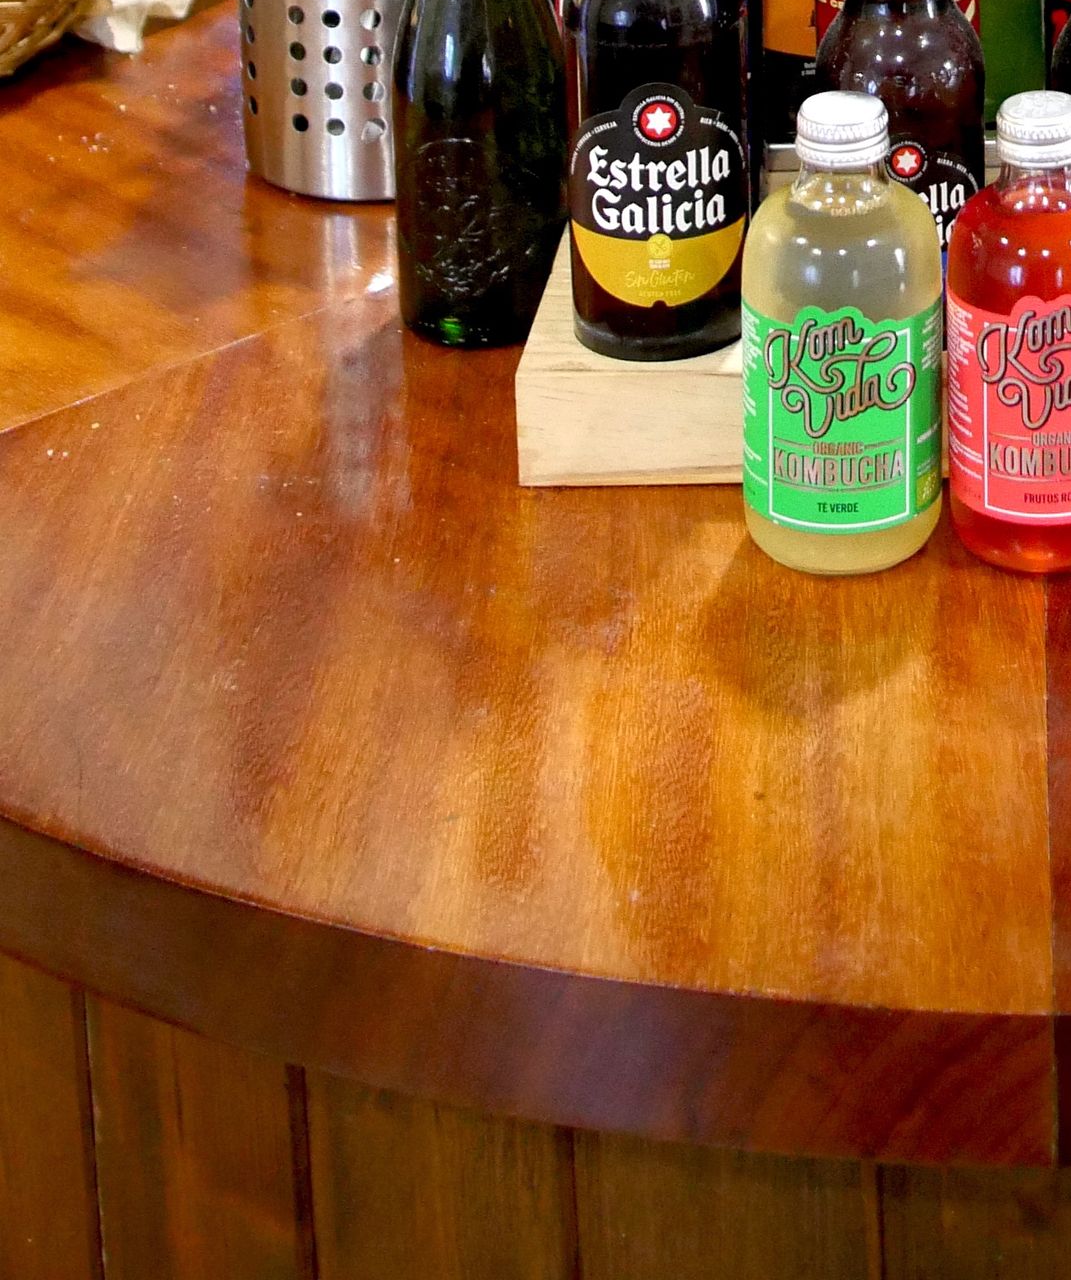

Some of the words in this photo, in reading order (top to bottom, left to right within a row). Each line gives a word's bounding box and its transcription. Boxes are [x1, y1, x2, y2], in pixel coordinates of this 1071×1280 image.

[586, 144, 730, 192] Estrella
[591, 188, 726, 234] Galicia
[763, 316, 864, 394] Kom
[781, 331, 916, 438] Vida
[773, 448, 904, 486] KOMBUCHA
[813, 441, 864, 456] ORGANIC
[829, 502, 859, 513] VERDE
[1024, 491, 1059, 504] FRUTOS
